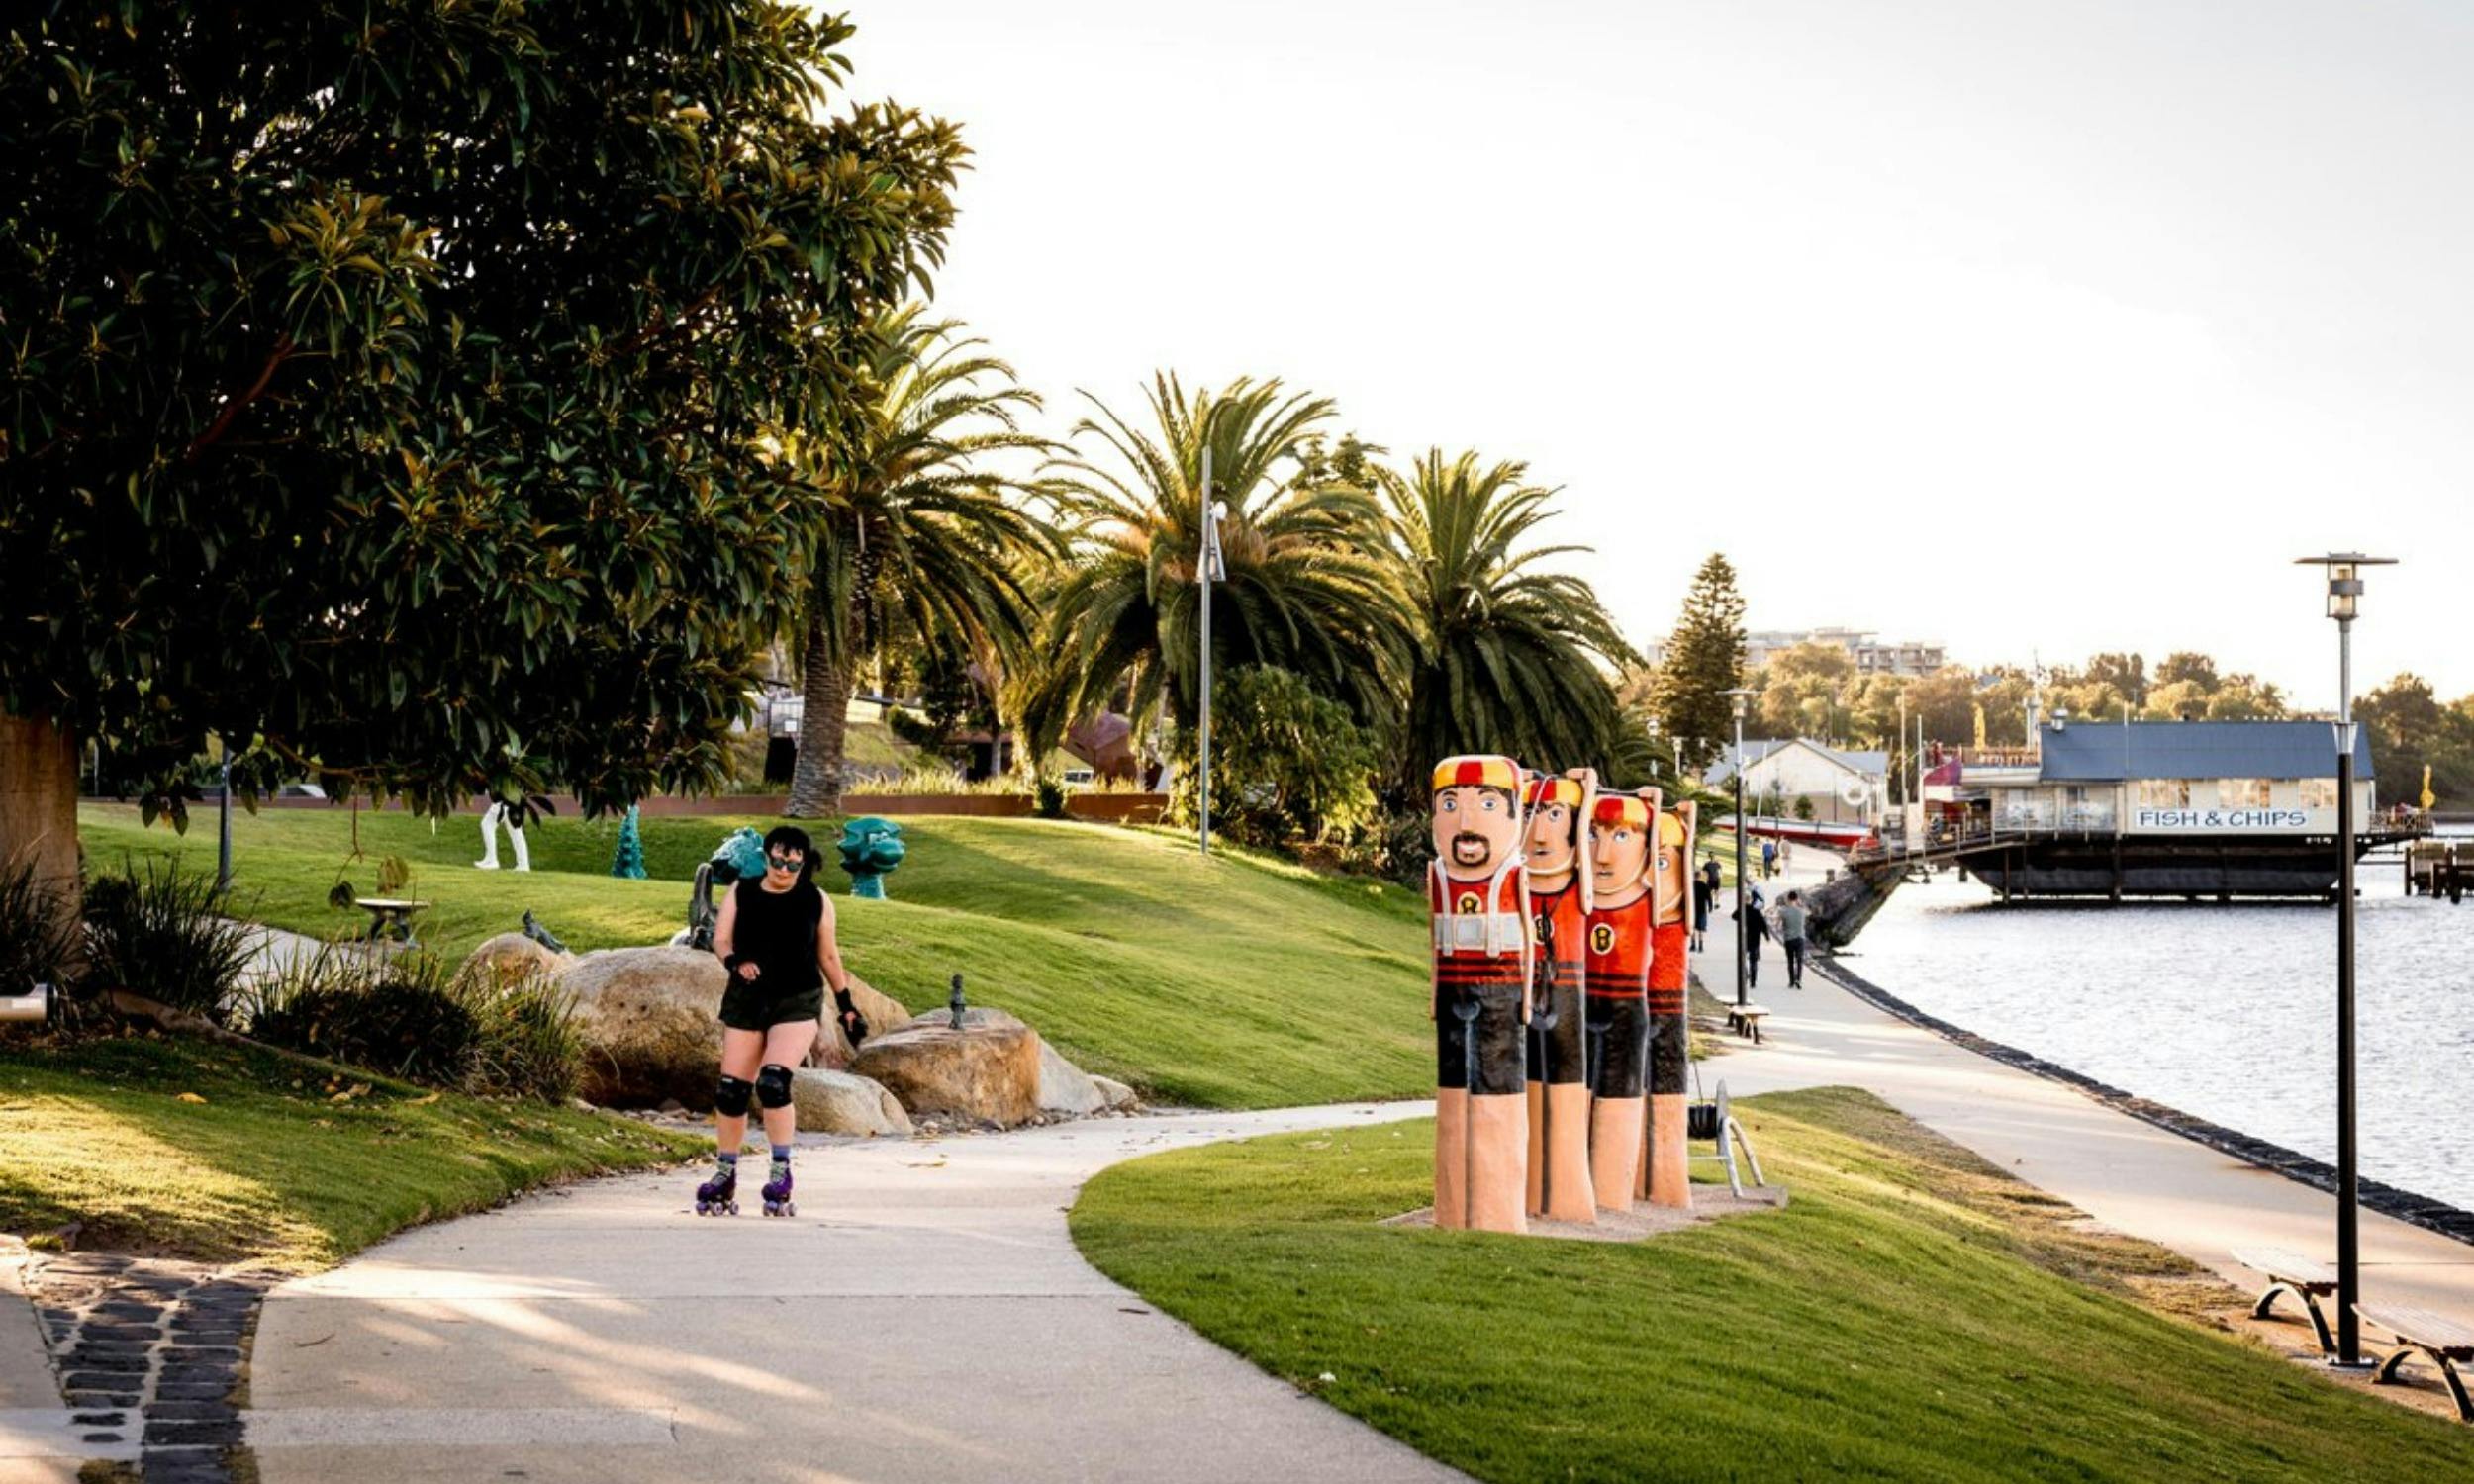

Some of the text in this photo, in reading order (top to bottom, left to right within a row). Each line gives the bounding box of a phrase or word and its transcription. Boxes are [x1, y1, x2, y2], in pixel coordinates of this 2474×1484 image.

[2140, 811, 2307, 827] FISH & CHIPS
